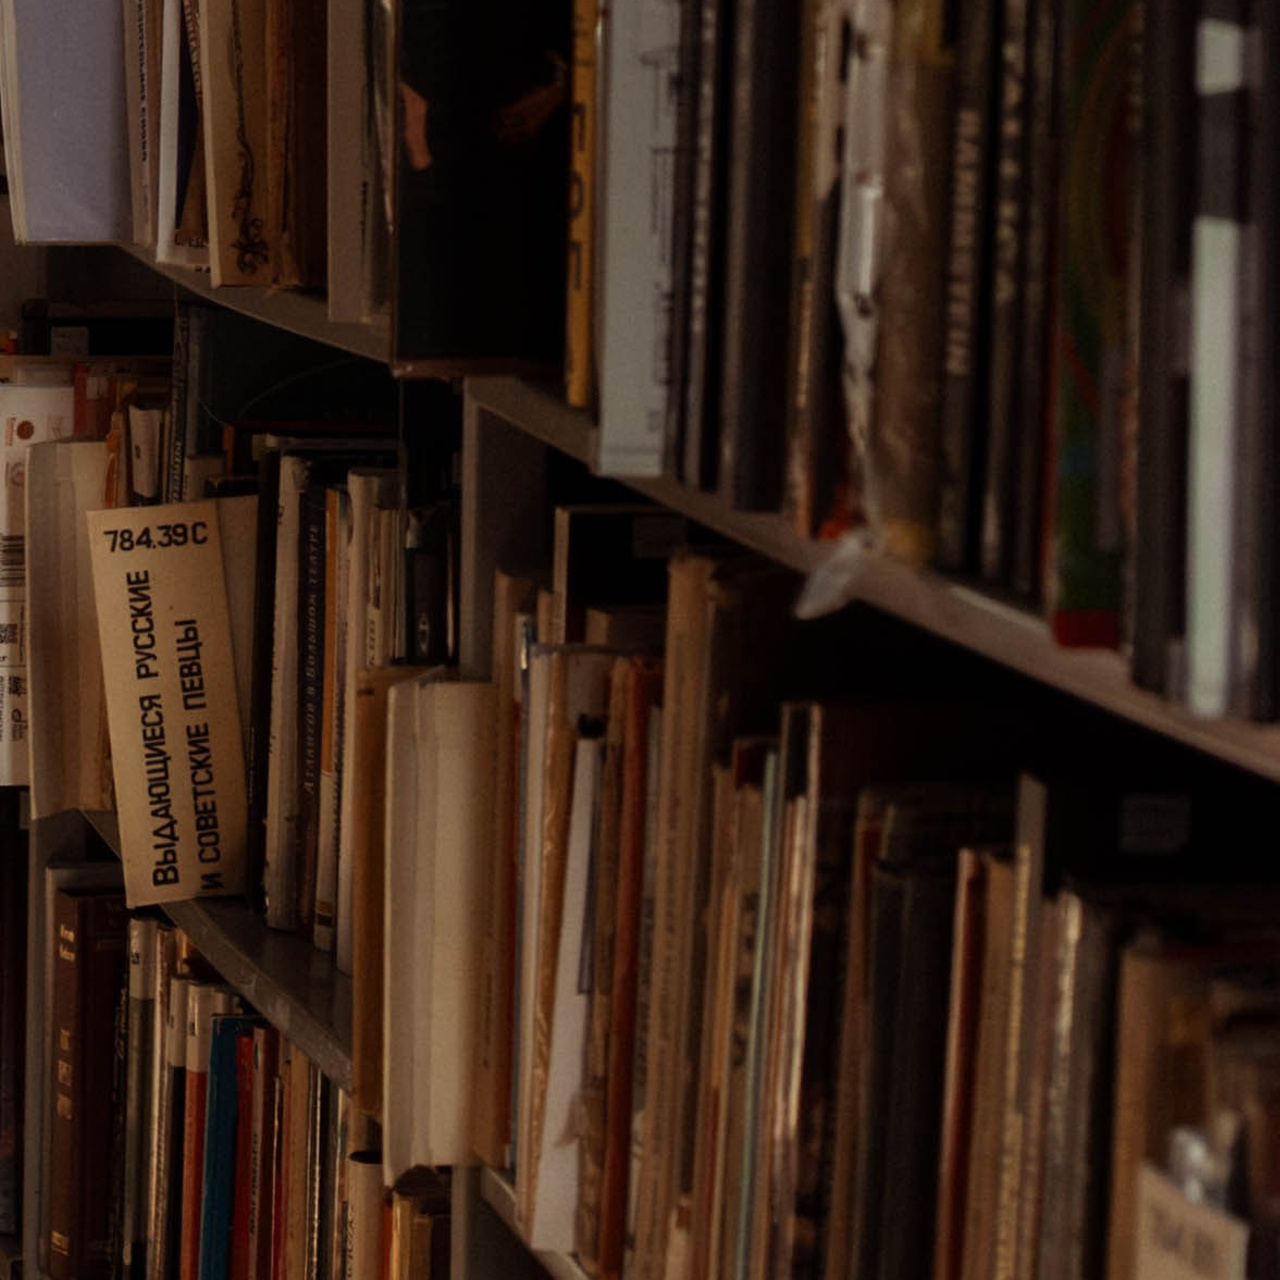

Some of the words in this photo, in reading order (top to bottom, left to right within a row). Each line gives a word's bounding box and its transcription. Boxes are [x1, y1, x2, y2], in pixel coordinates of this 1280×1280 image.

[125, 569, 159, 679] РУССКИЕ
[175, 620, 207, 710] ПЕВЦЫ
[186, 723, 222, 863] СОВЕТСКИЕ
[201, 873, 224, 889] И
